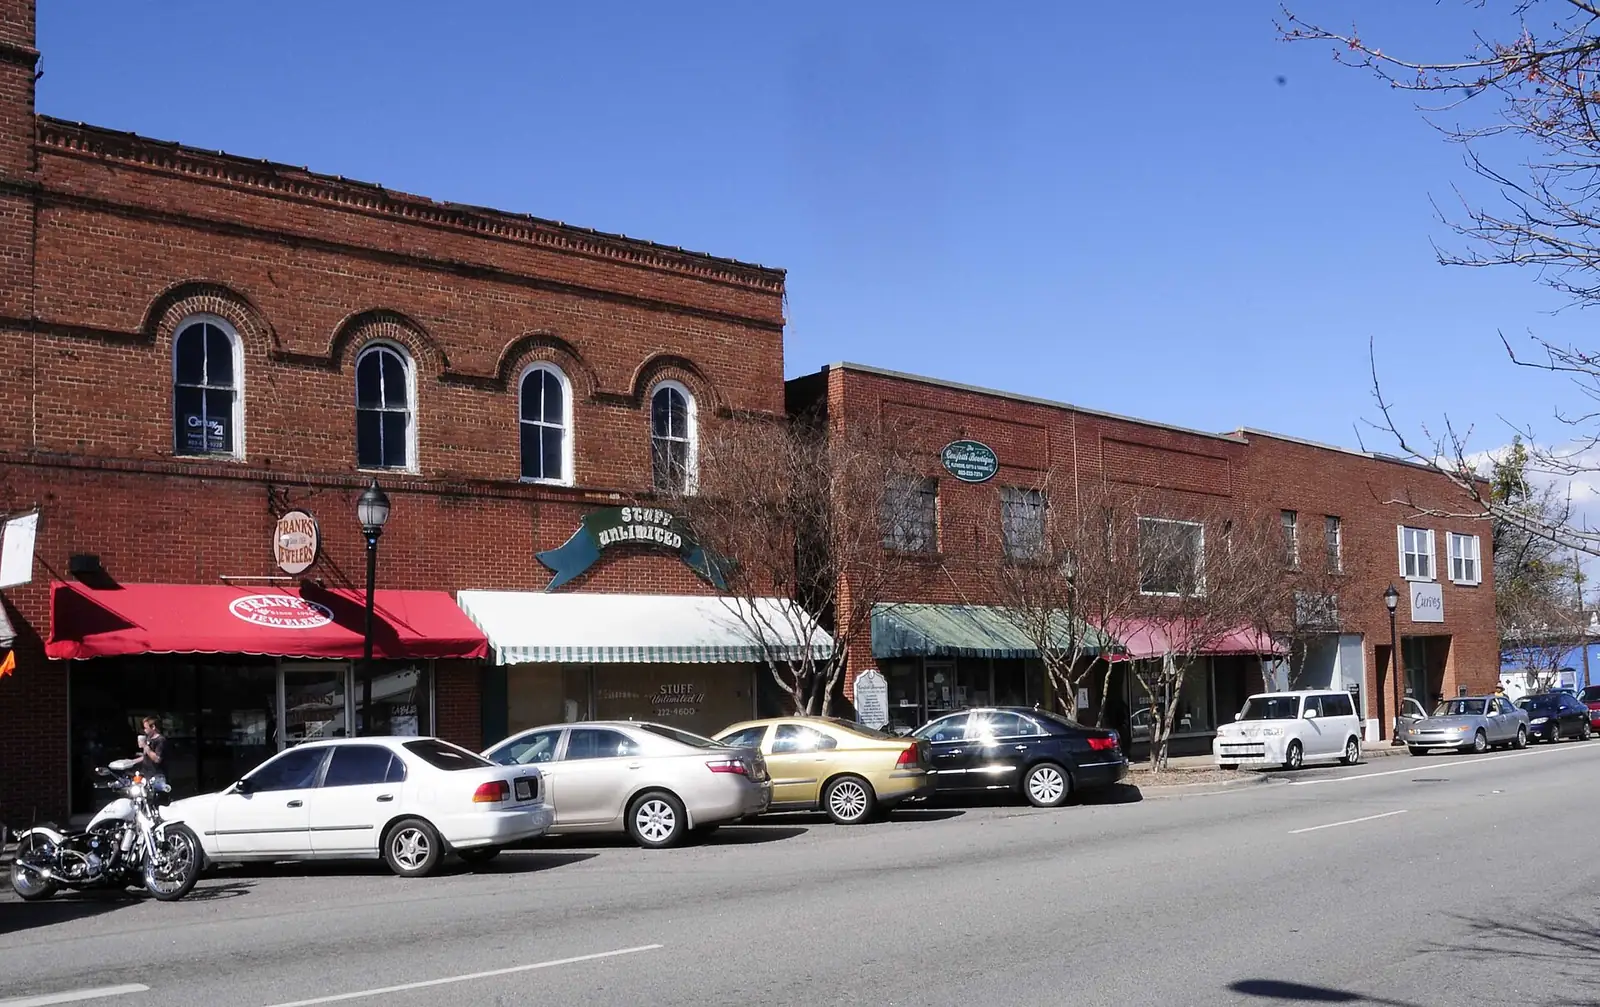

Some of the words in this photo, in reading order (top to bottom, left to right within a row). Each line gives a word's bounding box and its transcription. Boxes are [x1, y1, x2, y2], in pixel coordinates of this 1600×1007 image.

[214, 425, 223, 435] 21
[621, 507, 673, 526] STUFF
[598, 525, 682, 548] UNLIMITED
[279, 543, 313, 566] JEWELERS
[1415, 592, 1441, 610] Curves
[248, 613, 327, 626] JEWELERS
[660, 683, 694, 694] STUFF
[651, 693, 695, 704] Unlimited
